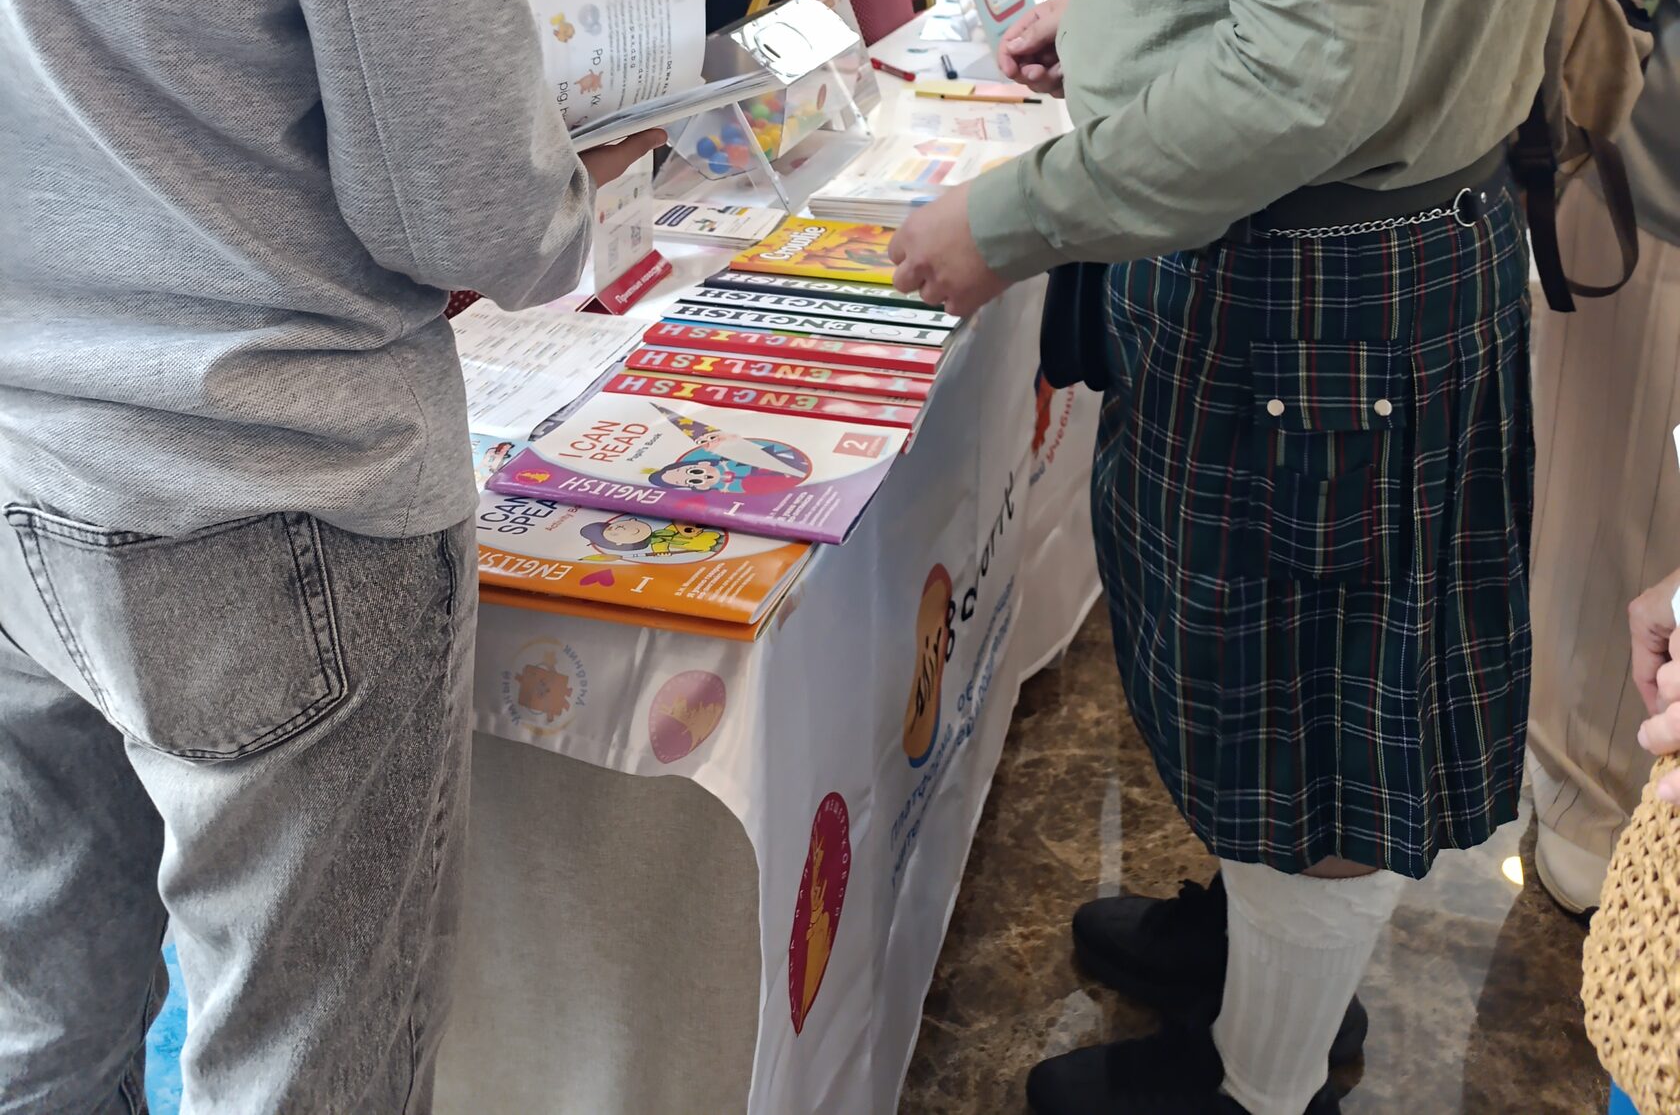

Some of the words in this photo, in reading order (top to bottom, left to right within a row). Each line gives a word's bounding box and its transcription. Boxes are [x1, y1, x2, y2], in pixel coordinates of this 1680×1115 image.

[696, 289, 869, 314] ENGLISH
[675, 306, 856, 331] ENGLISH
[658, 323, 845, 352] ENGLISH
[914, 330, 931, 340] I
[898, 347, 920, 360] I
[640, 351, 832, 383] ENGLISH
[617, 376, 820, 410] ENGLISH
[888, 376, 912, 392] I
[875, 405, 901, 421] I
[1045, 383, 1077, 465] Учебни
[570, 420, 622, 451] CAN
[589, 423, 649, 462] READ
[842, 439, 869, 450] 2
[558, 476, 667, 504] ENGLISH
[497, 498, 559, 535] SPEA
[724, 501, 745, 517] I
[631, 576, 654, 593] I
